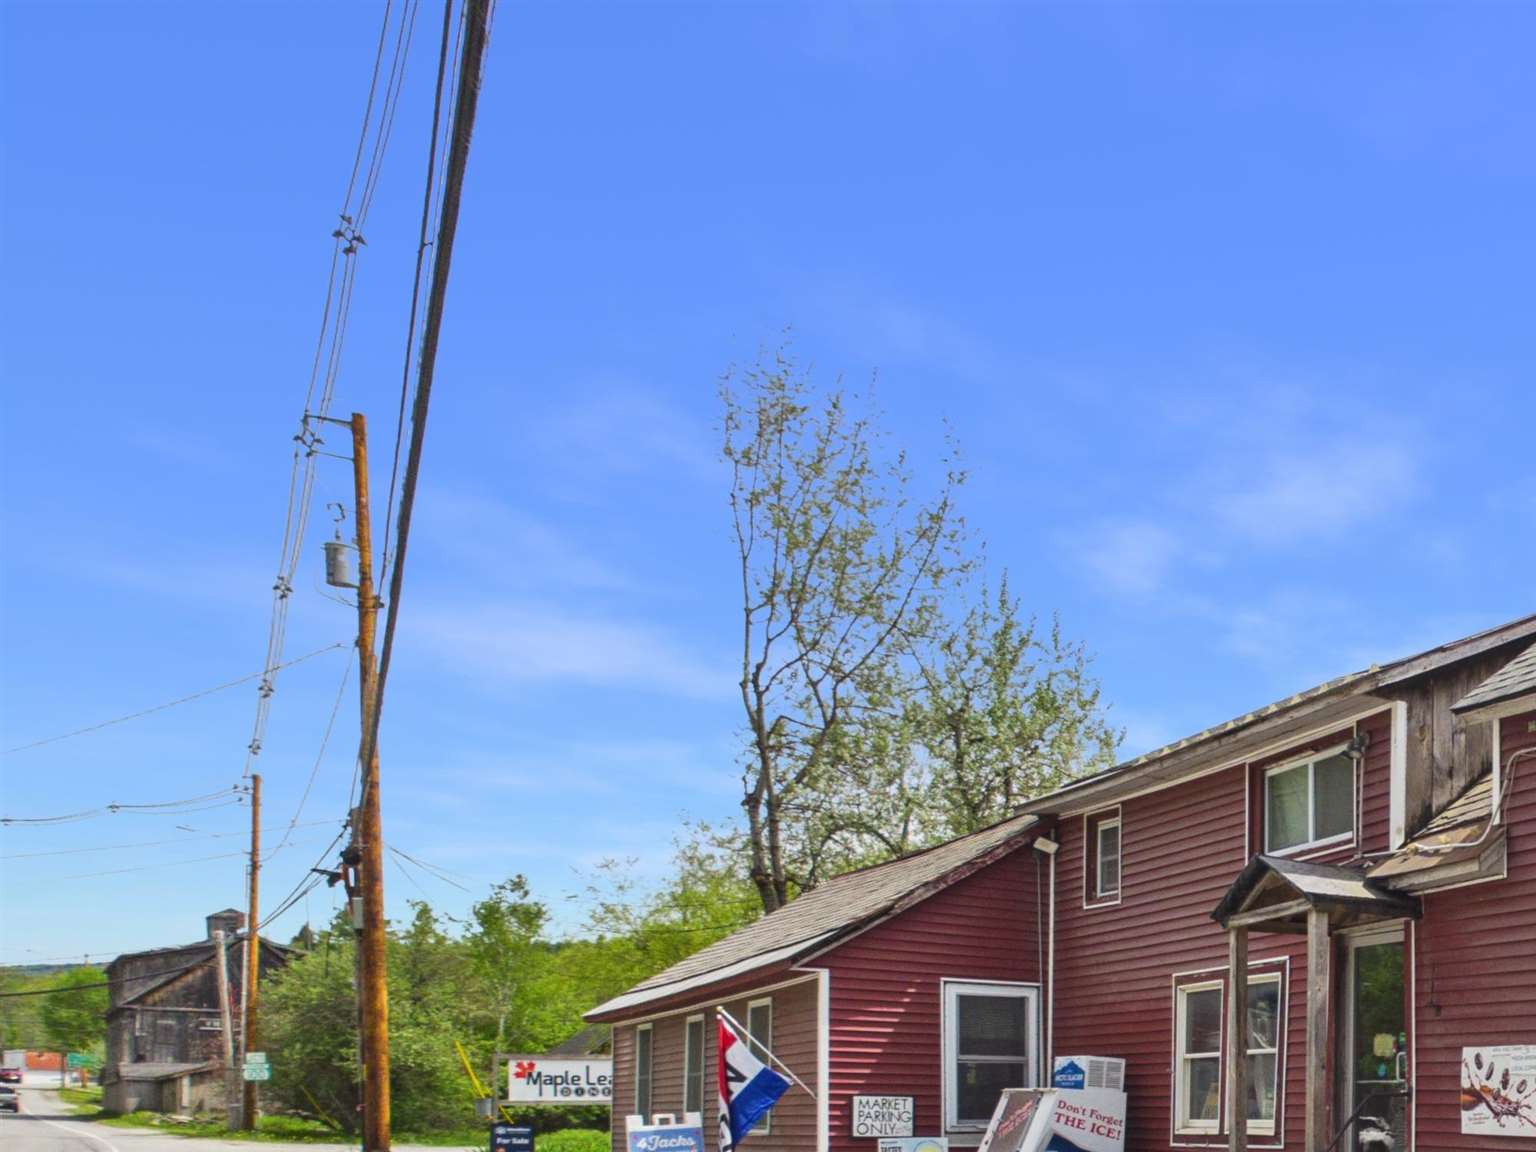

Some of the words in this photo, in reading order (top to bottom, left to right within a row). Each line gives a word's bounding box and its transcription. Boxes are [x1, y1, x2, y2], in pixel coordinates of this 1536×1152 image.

[526, 1070, 581, 1096] Maple
[858, 1098, 908, 1110] MARKET
[1056, 1100, 1086, 1117] Don't
[1090, 1108, 1124, 1128] Forget
[858, 1110, 912, 1123] PARKING
[856, 1122, 897, 1136] ONLY
[1055, 1112, 1086, 1131] THE
[1090, 1122, 1122, 1142] ICE!
